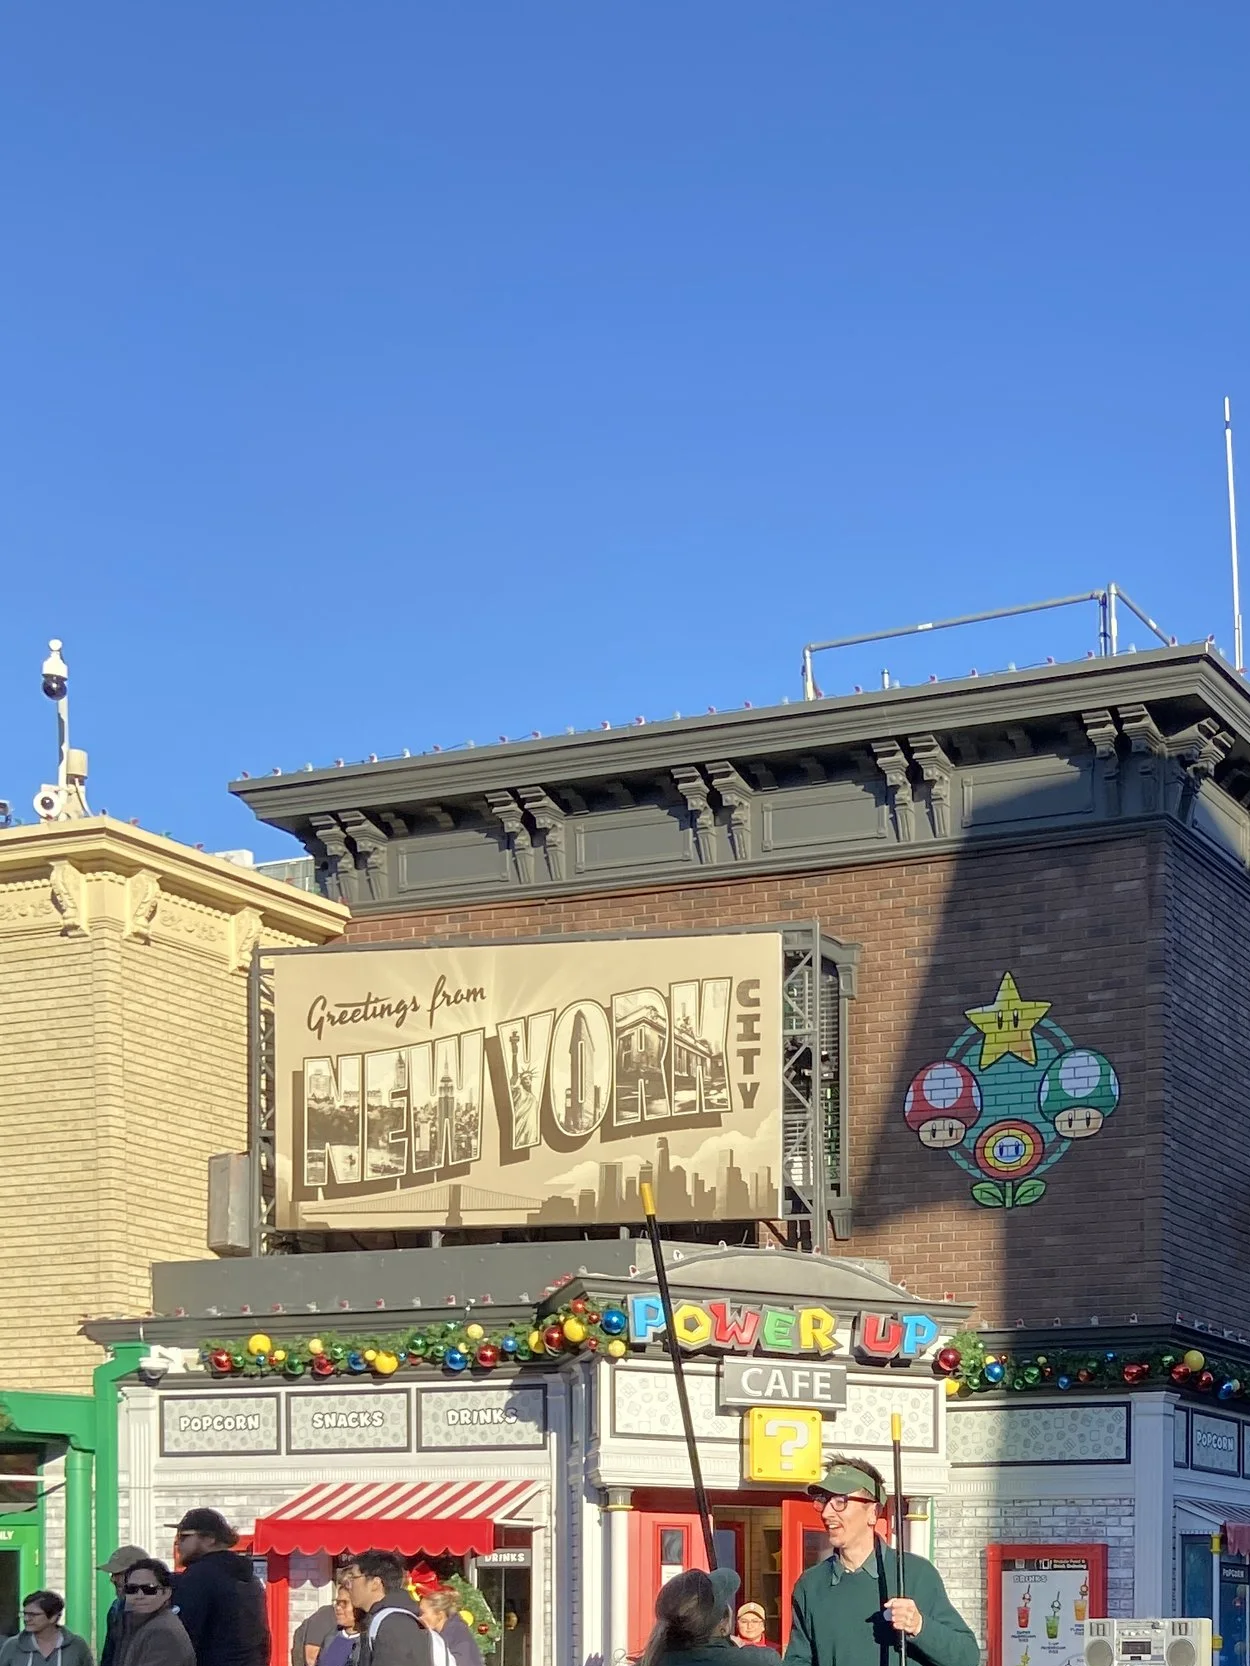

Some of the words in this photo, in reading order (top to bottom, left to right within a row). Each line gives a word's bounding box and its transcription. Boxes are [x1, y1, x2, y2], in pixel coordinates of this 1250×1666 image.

[307, 994, 420, 1040] Greetings
[429, 974, 487, 1028] from
[736, 979, 760, 1109] CITY
[302, 1027, 485, 1187] NEW
[496, 976, 733, 1150] YORK
[629, 1293, 840, 1355] POWER
[859, 1311, 940, 1360] UP
[741, 1367, 832, 1400] CAFE
[179, 1413, 260, 1432] POPCORN
[312, 1411, 384, 1430] SNACKS
[446, 1407, 518, 1426] DRINKS
[1196, 1429, 1235, 1452] POPCORN
[484, 1552, 525, 1563] DRINKS
[1012, 1574, 1048, 1583] DRINKS
[1222, 1567, 1245, 1579] POPCORN
